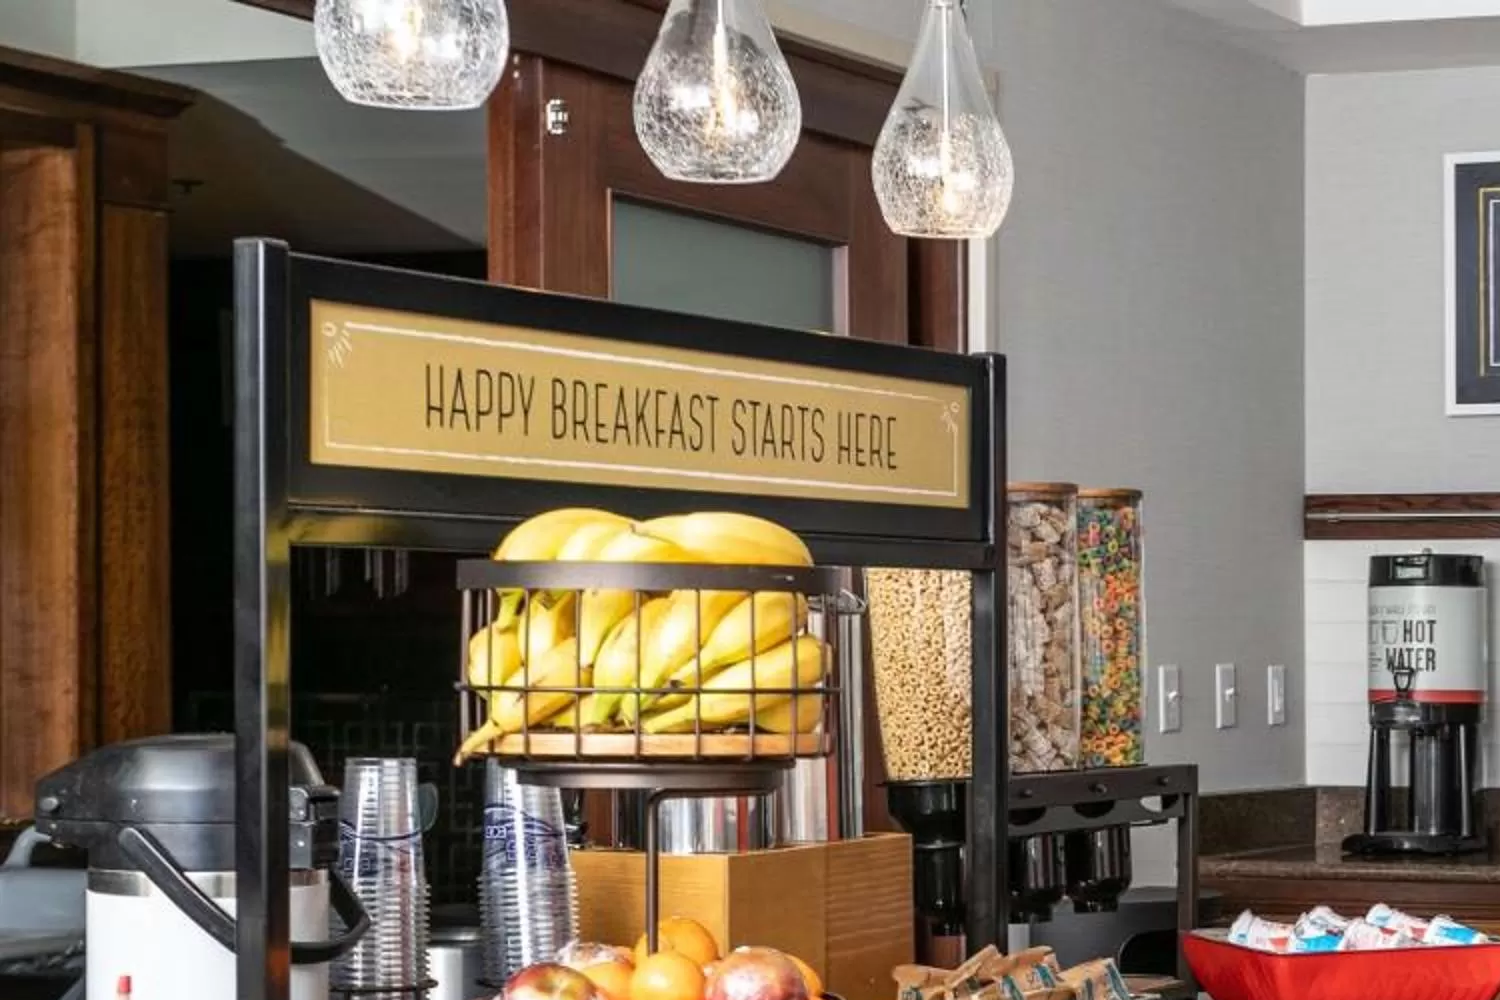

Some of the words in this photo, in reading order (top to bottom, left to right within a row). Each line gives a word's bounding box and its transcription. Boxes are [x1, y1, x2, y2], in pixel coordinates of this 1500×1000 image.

[424, 363, 536, 437] HAPPY
[550, 377, 720, 454] BREAKFAST
[730, 402, 826, 464] STARTS
[836, 412, 899, 471] HERE
[1403, 619, 1437, 644] HOT
[1386, 647, 1437, 672] WATER
